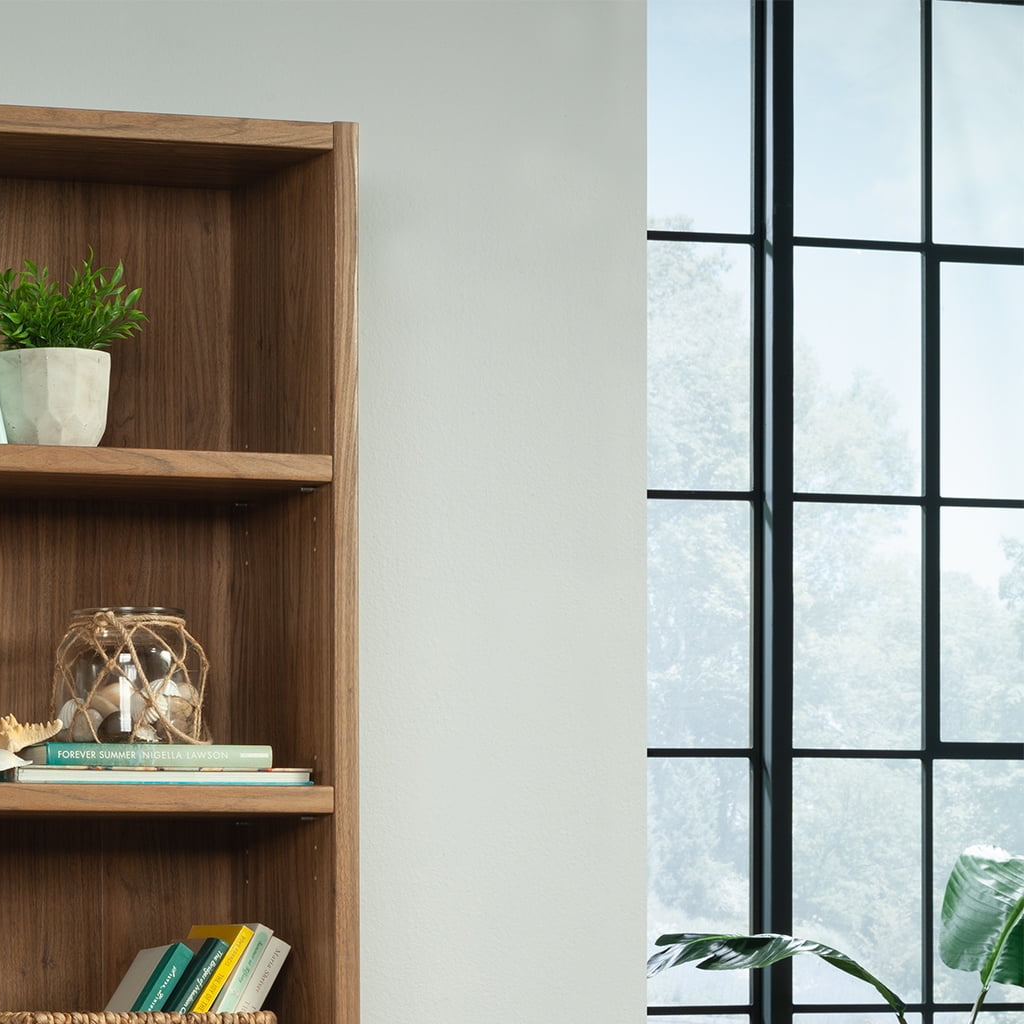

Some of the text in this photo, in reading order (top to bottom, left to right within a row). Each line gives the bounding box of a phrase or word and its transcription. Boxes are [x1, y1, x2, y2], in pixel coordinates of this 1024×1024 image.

[57, 750, 229, 760] FOREVER SUMMER NIGELLA LAWSON
[213, 950, 223, 961] The
[268, 949, 281, 968] Maria
[202, 960, 217, 979] Bridges
[196, 978, 204, 987] of
